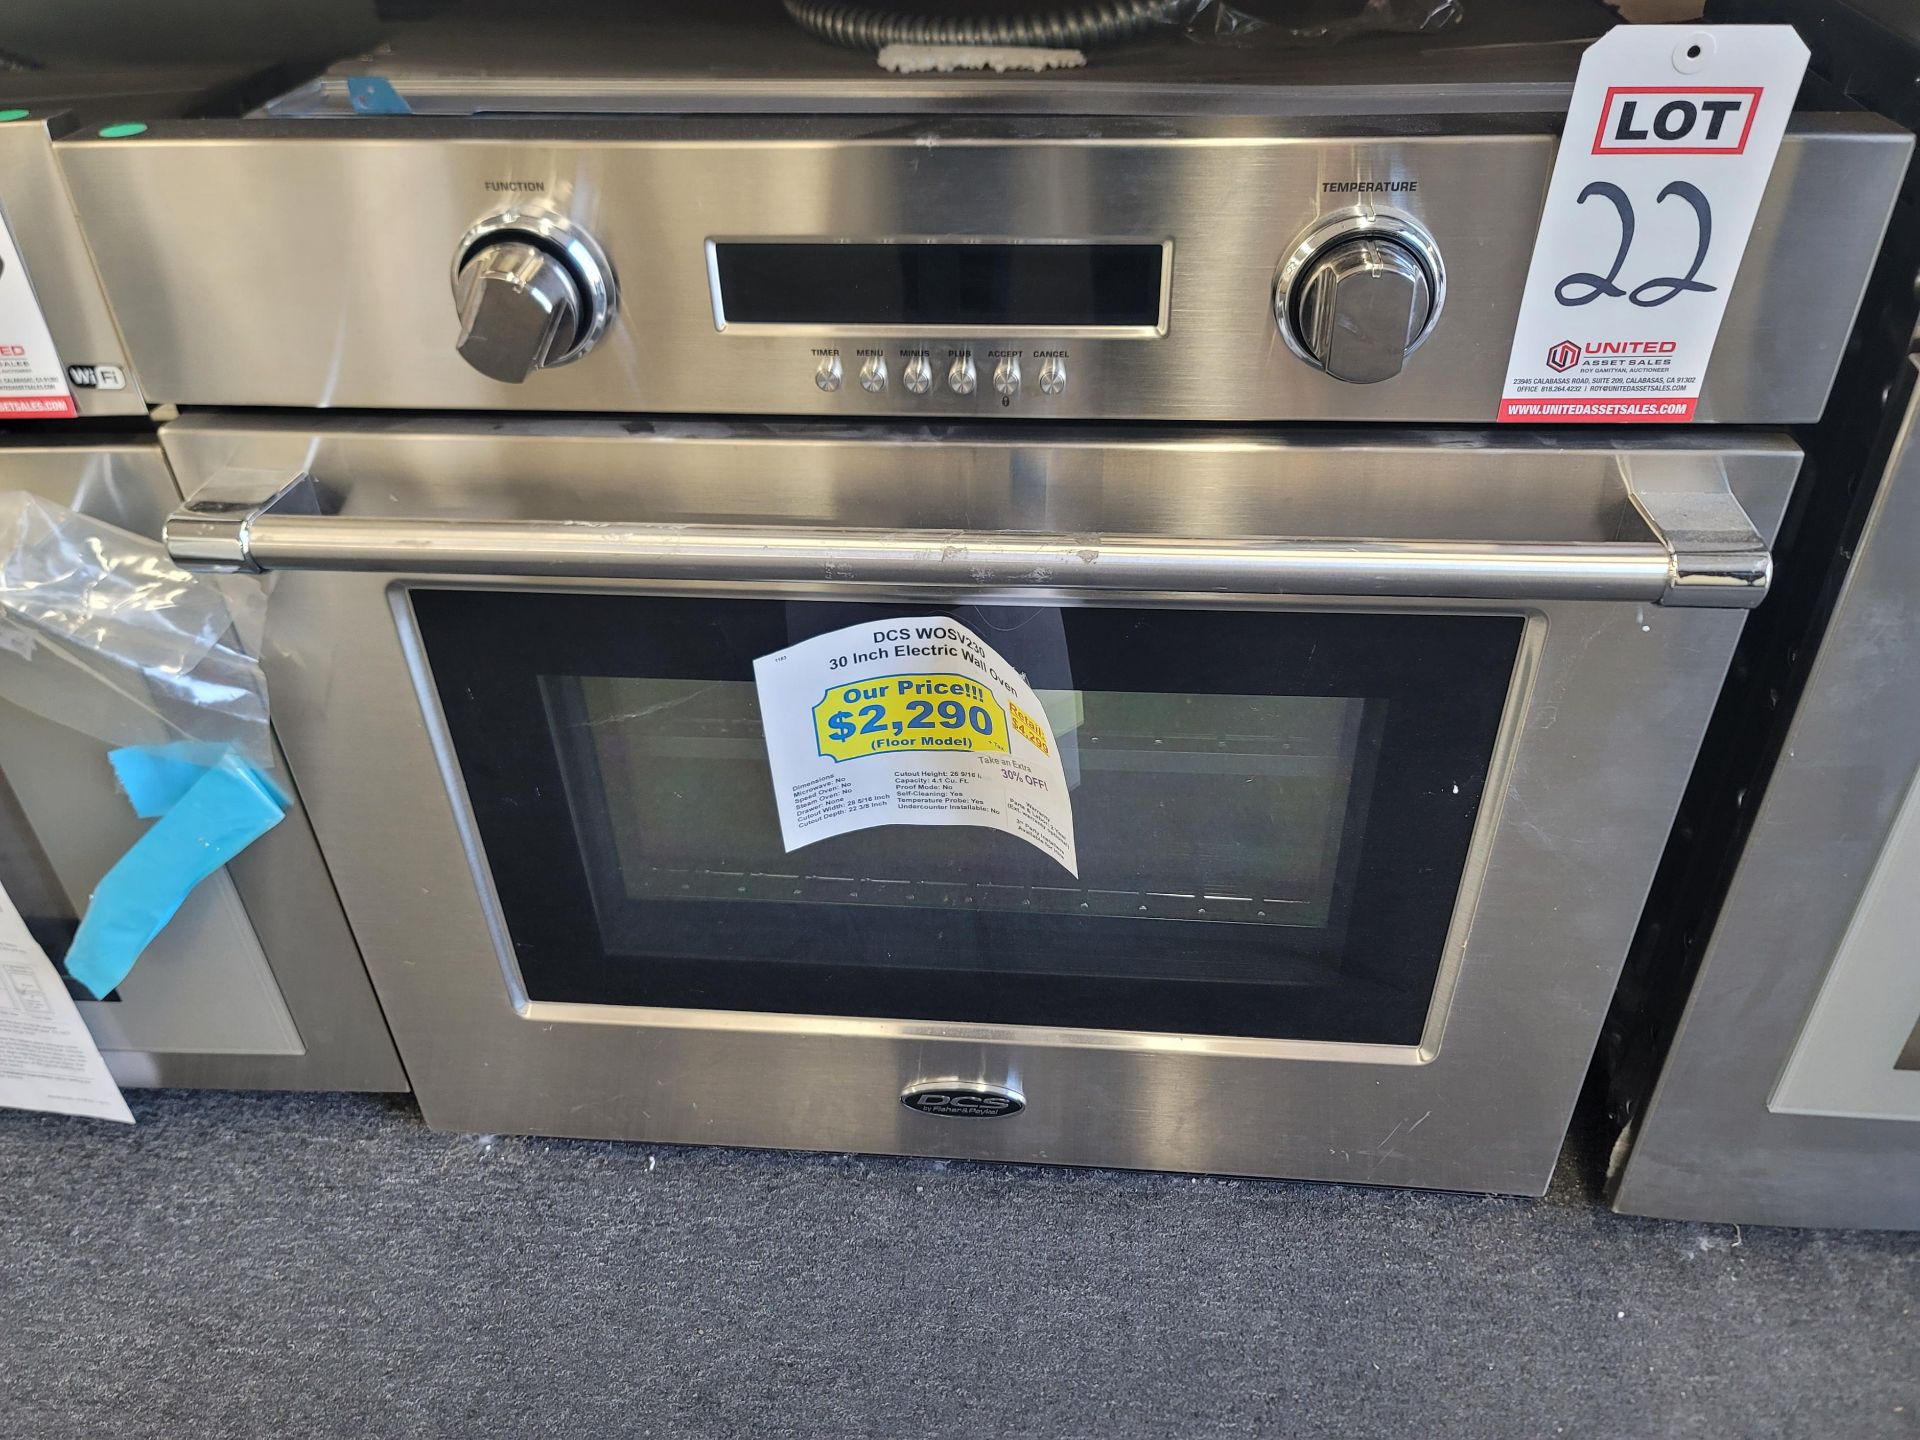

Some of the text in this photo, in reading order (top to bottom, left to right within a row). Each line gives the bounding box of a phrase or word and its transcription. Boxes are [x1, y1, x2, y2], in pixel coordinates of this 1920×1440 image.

[1614, 100, 1742, 141] LOT
[485, 181, 545, 191] FUNCTION
[1322, 181, 1417, 192] TEMPERATURE
[1554, 181, 1718, 307] 22
[811, 349, 840, 357] TIMER
[856, 349, 884, 357] MENU
[988, 350, 1023, 358] ACCEPT
[1585, 341, 1677, 354] UNITED
[1508, 403, 1687, 415] WWW.UNITEDASSETSALES.COM
[874, 627, 986, 658] DCS WOSV230
[829, 644, 1018, 697] 30 Inch Electric Wall Oven
[843, 680, 984, 703] Our Price!!!
[828, 700, 993, 742] $2,290
[871, 736, 972, 751] (Floor Model)
[978, 756, 999, 764] Take
[1012, 760, 1032, 772] Extra
[792, 773, 835, 792] Dimensions
[921, 770, 948, 778] Height:
[1001, 768, 1023, 783] 30%
[1024, 774, 1049, 791] OFF!
[793, 780, 834, 798] Microwave:
[794, 792, 817, 804] Speed
[818, 785, 840, 795] Oven:
[795, 799, 818, 810] Steam
[819, 792, 841, 801] Oven:
[796, 797, 844, 817] Drawer: None
[797, 811, 822, 822] Cutout
[822, 803, 845, 816] Width:
[874, 793, 891, 801] Inch
[949, 804, 989, 812] Installable:
[990, 807, 1000, 815] No
[798, 817, 823, 828] Cutout
[823, 809, 847, 819] Depth:
[871, 800, 887, 808] Inch
[917, 1094, 1010, 1109] DCS
